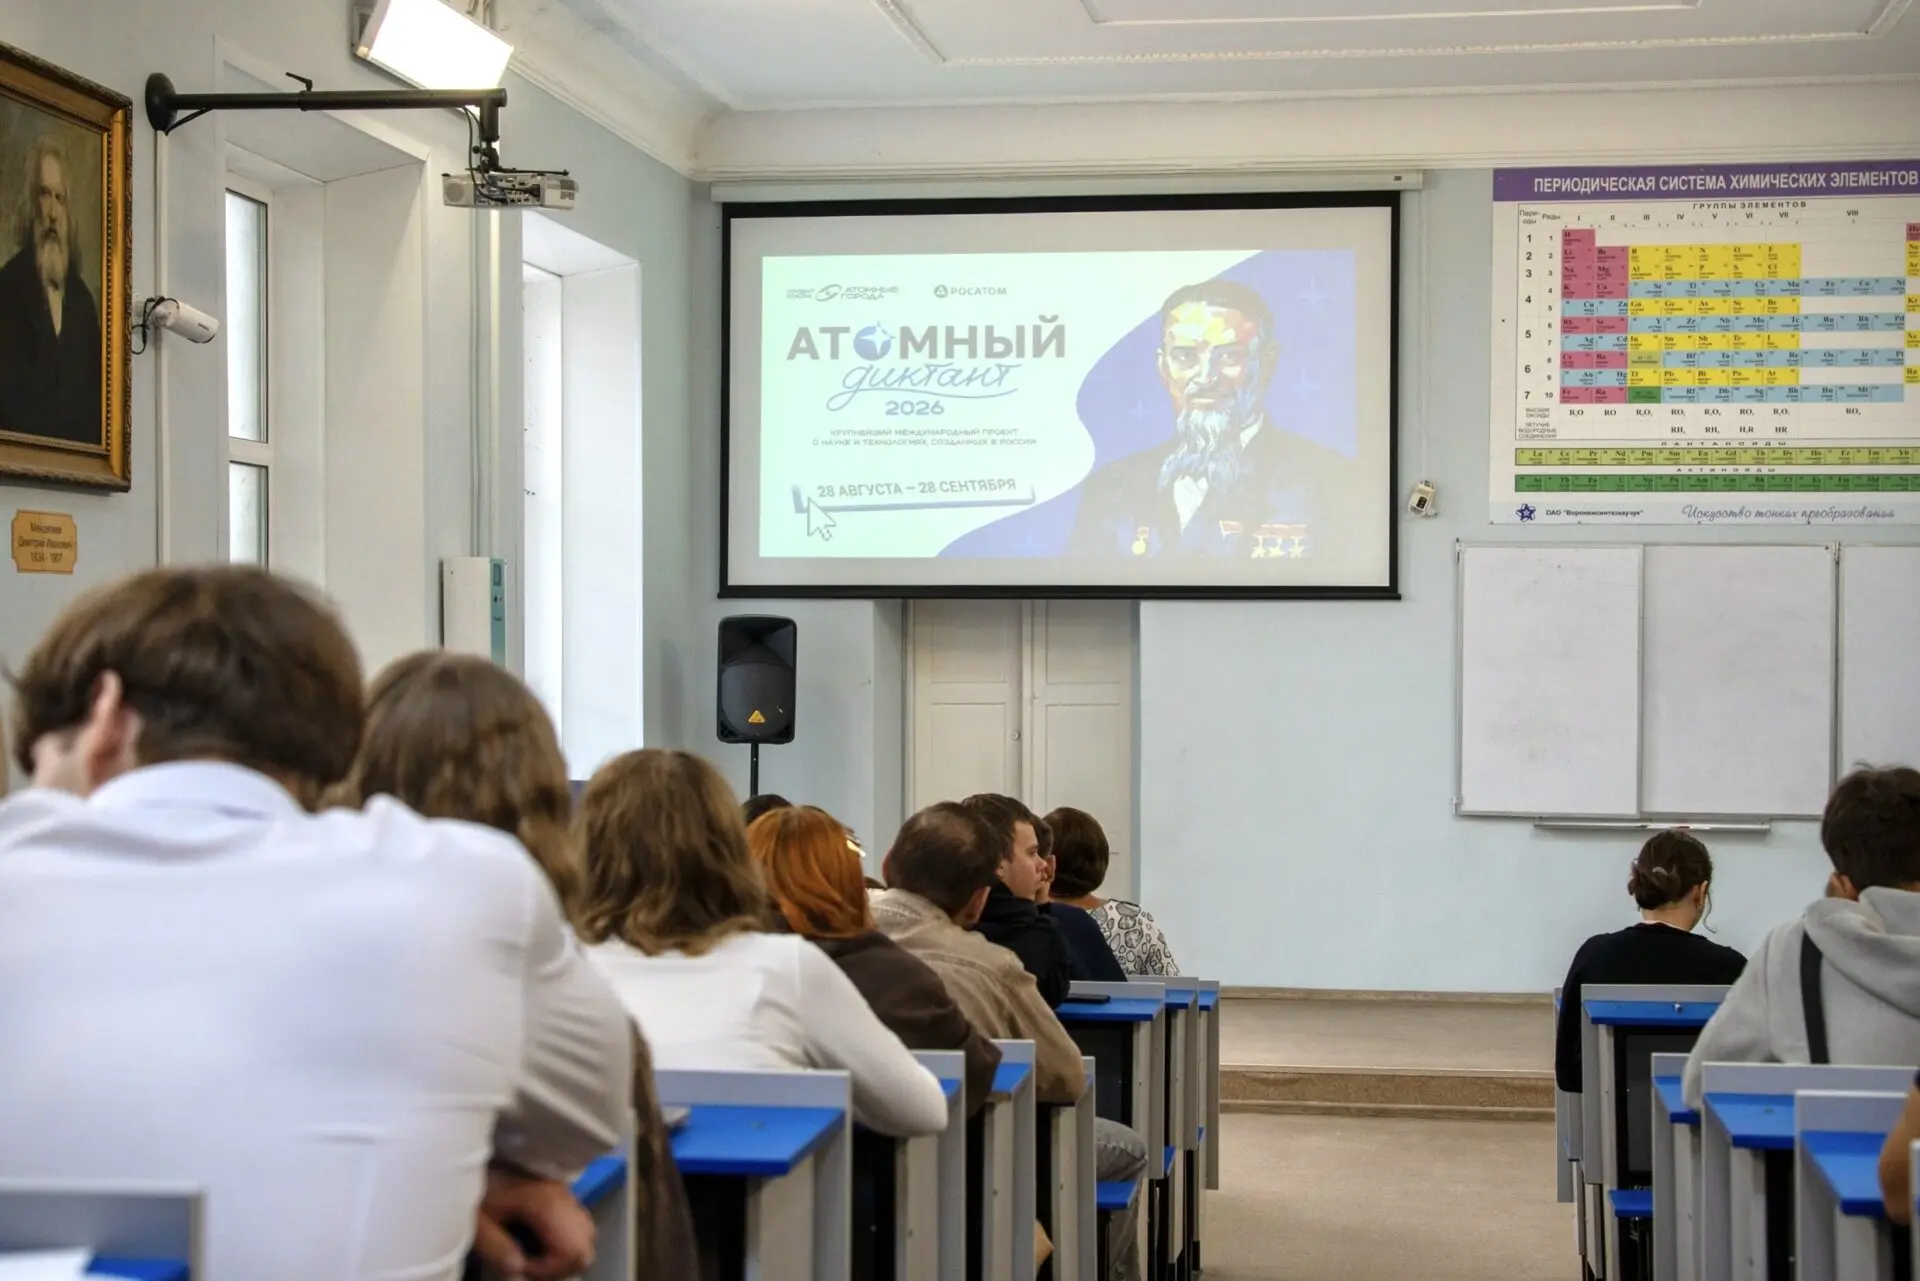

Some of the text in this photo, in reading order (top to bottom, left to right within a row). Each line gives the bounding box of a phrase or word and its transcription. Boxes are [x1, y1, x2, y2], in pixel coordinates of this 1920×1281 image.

[1535, 170, 1919, 193] ПЕРИОДИЧЕСКАЯ СИСТЕМА ХИМИЧЕСКИХ ЭЛЕМЕНТОВ
[1740, 201, 1806, 209] ЭЛЕМЕНТОВ
[1526, 234, 1532, 243] 1
[1525, 251, 1532, 260] 2
[1525, 269, 1532, 278] 3
[950, 287, 1007, 296] РОСАТОМ
[1525, 295, 1532, 303] 4
[786, 314, 1066, 361] АТОМНЫЙ
[1525, 329, 1532, 339] 5
[1524, 364, 1531, 374] 6
[826, 362, 1022, 411] диктант
[1524, 391, 1531, 400] 7
[884, 400, 945, 416] 2026
[830, 427, 1018, 437] КРУПНЕЙШИЙ МЕЖДУНАРОДНЫЙ ПРОЕКТ
[930, 438, 988, 446] СОЗДАННЫХ
[999, 438, 1037, 446] РОССИИ
[817, 485, 836, 498] 28
[838, 483, 903, 497] АВГУСТА
[919, 481, 936, 494] 28
[938, 479, 1017, 493] СЕНТЯБРЯ
[1682, 505, 1751, 522] Искусство
[1754, 509, 1797, 519] тонких
